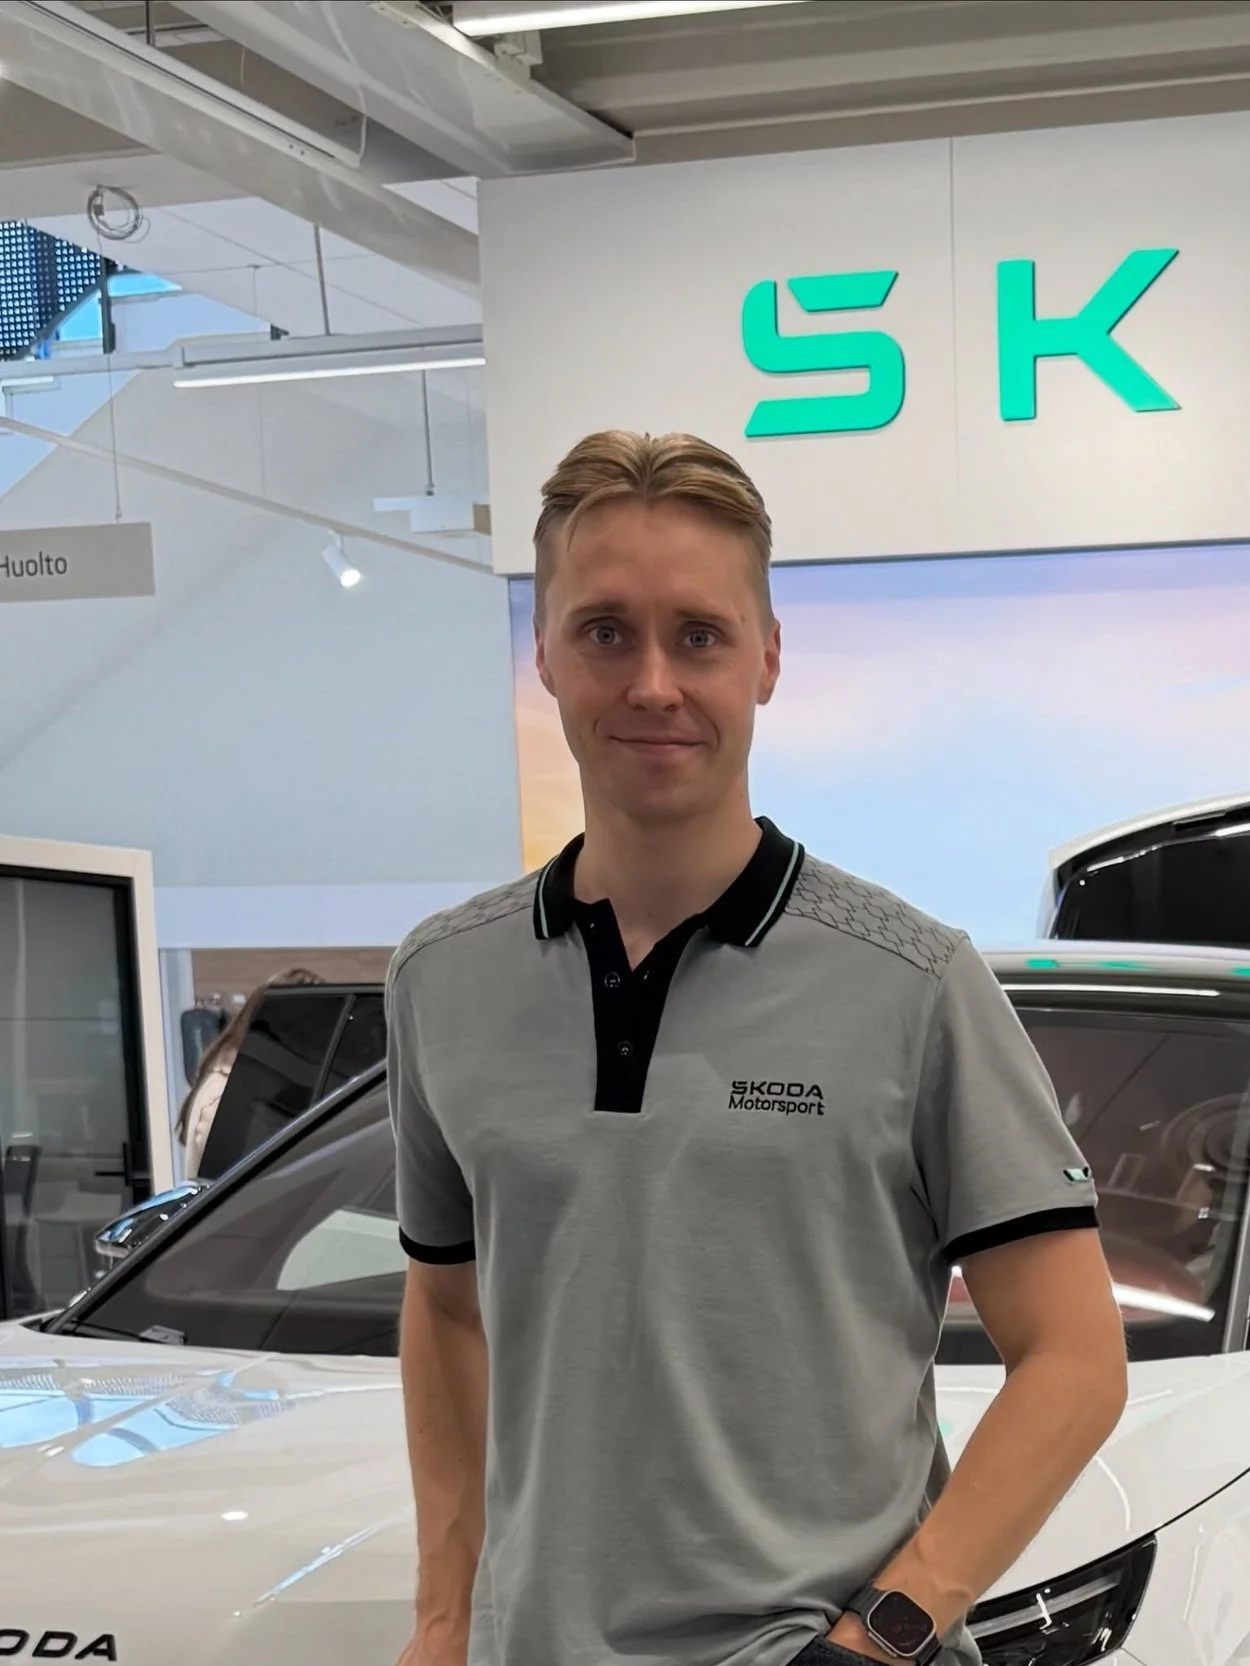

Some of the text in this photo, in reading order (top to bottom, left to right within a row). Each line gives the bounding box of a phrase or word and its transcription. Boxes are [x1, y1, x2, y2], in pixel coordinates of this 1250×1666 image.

[0, 551, 67, 578] Huolto
[731, 1080, 824, 1100] SKODA
[728, 1095, 825, 1116] Motorsport
